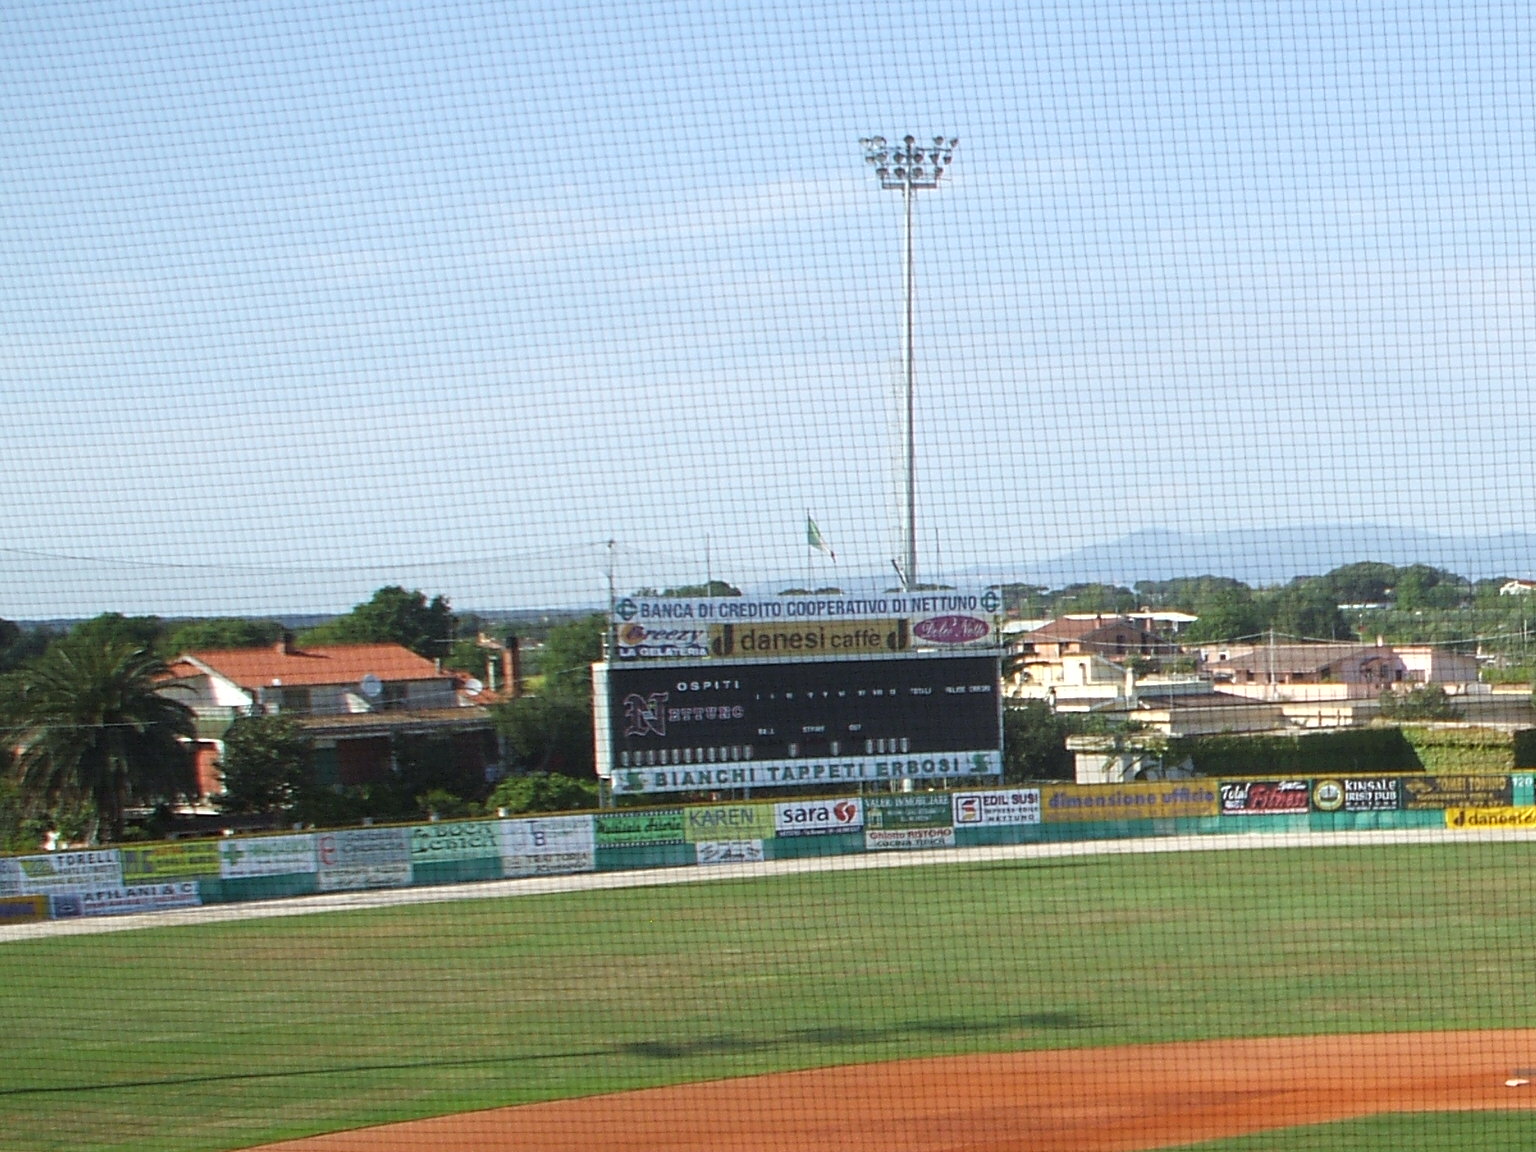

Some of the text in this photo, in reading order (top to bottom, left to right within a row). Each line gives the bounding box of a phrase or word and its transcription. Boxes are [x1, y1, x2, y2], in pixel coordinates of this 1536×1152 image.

[641, 596, 977, 618] BANCA DI CREDITO COOPERATIVO DI NETTUNO
[741, 626, 881, 652] danesi caffè
[640, 646, 708, 657] GELATERIA
[677, 680, 741, 692] OSPITI
[655, 758, 960, 787] BIANCHI TAPPETI ERBOSI
[1345, 779, 1396, 791] KINSALE
[984, 793, 1038, 807] EDIL SUSI
[1050, 787, 1215, 809] dimensione ufficio
[1374, 791, 1396, 801] PUB
[689, 807, 753, 827] KAREN
[783, 807, 829, 824] sara
